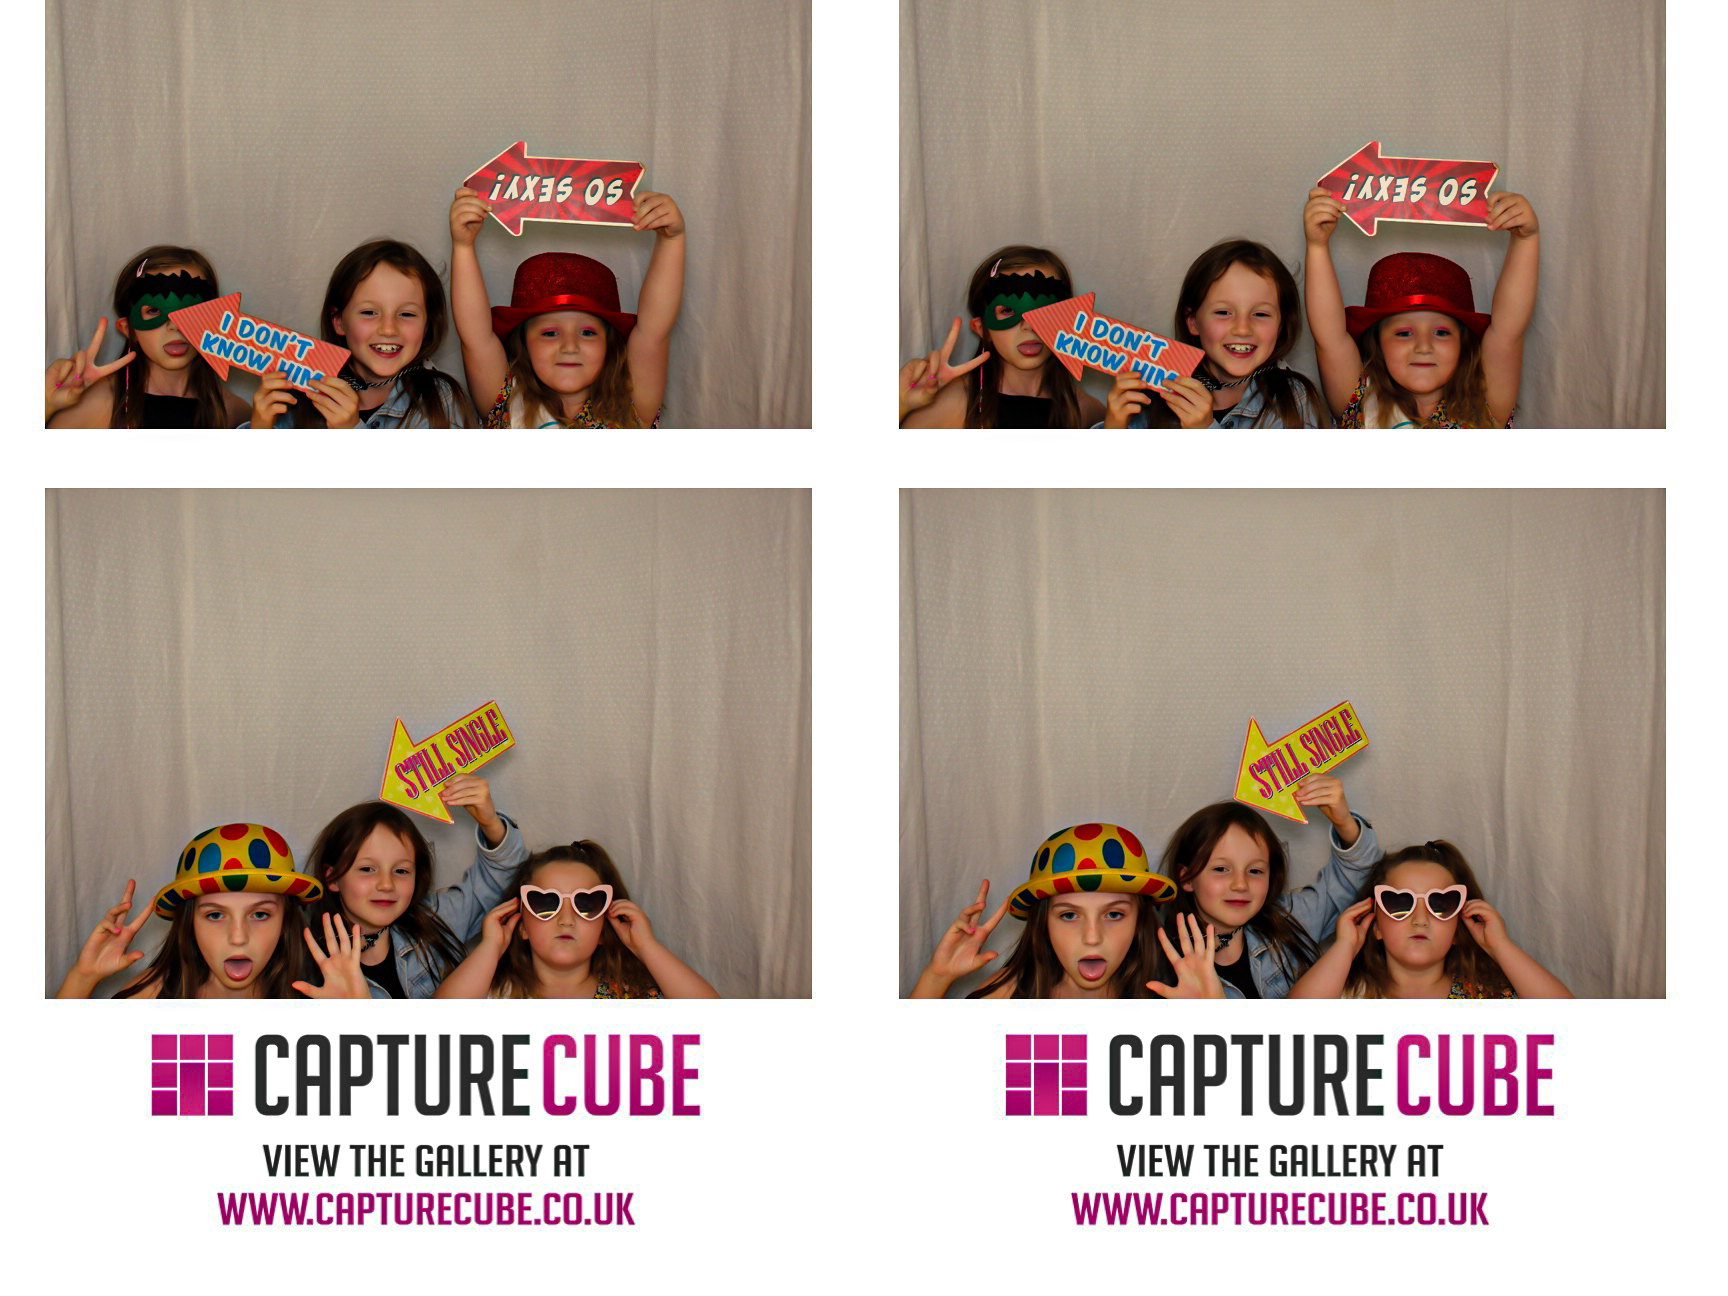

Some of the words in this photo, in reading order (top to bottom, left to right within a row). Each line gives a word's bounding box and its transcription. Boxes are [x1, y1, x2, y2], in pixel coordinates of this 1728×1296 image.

[487, 173, 574, 204] SEXY!
[584, 177, 623, 206] SO
[1341, 173, 1428, 204] SEXY!
[1438, 177, 1477, 206] SO
[201, 330, 274, 373] KNOW
[220, 311, 234, 334] I
[237, 317, 314, 360] DON'T
[1055, 330, 1128, 373] KNOW
[1074, 311, 1088, 334] I
[1091, 317, 1168, 360] DON'T
[395, 742, 456, 800] STILL
[445, 708, 509, 768] SINGLE
[1249, 742, 1310, 800] STILL
[1299, 708, 1363, 768] SINGLE
